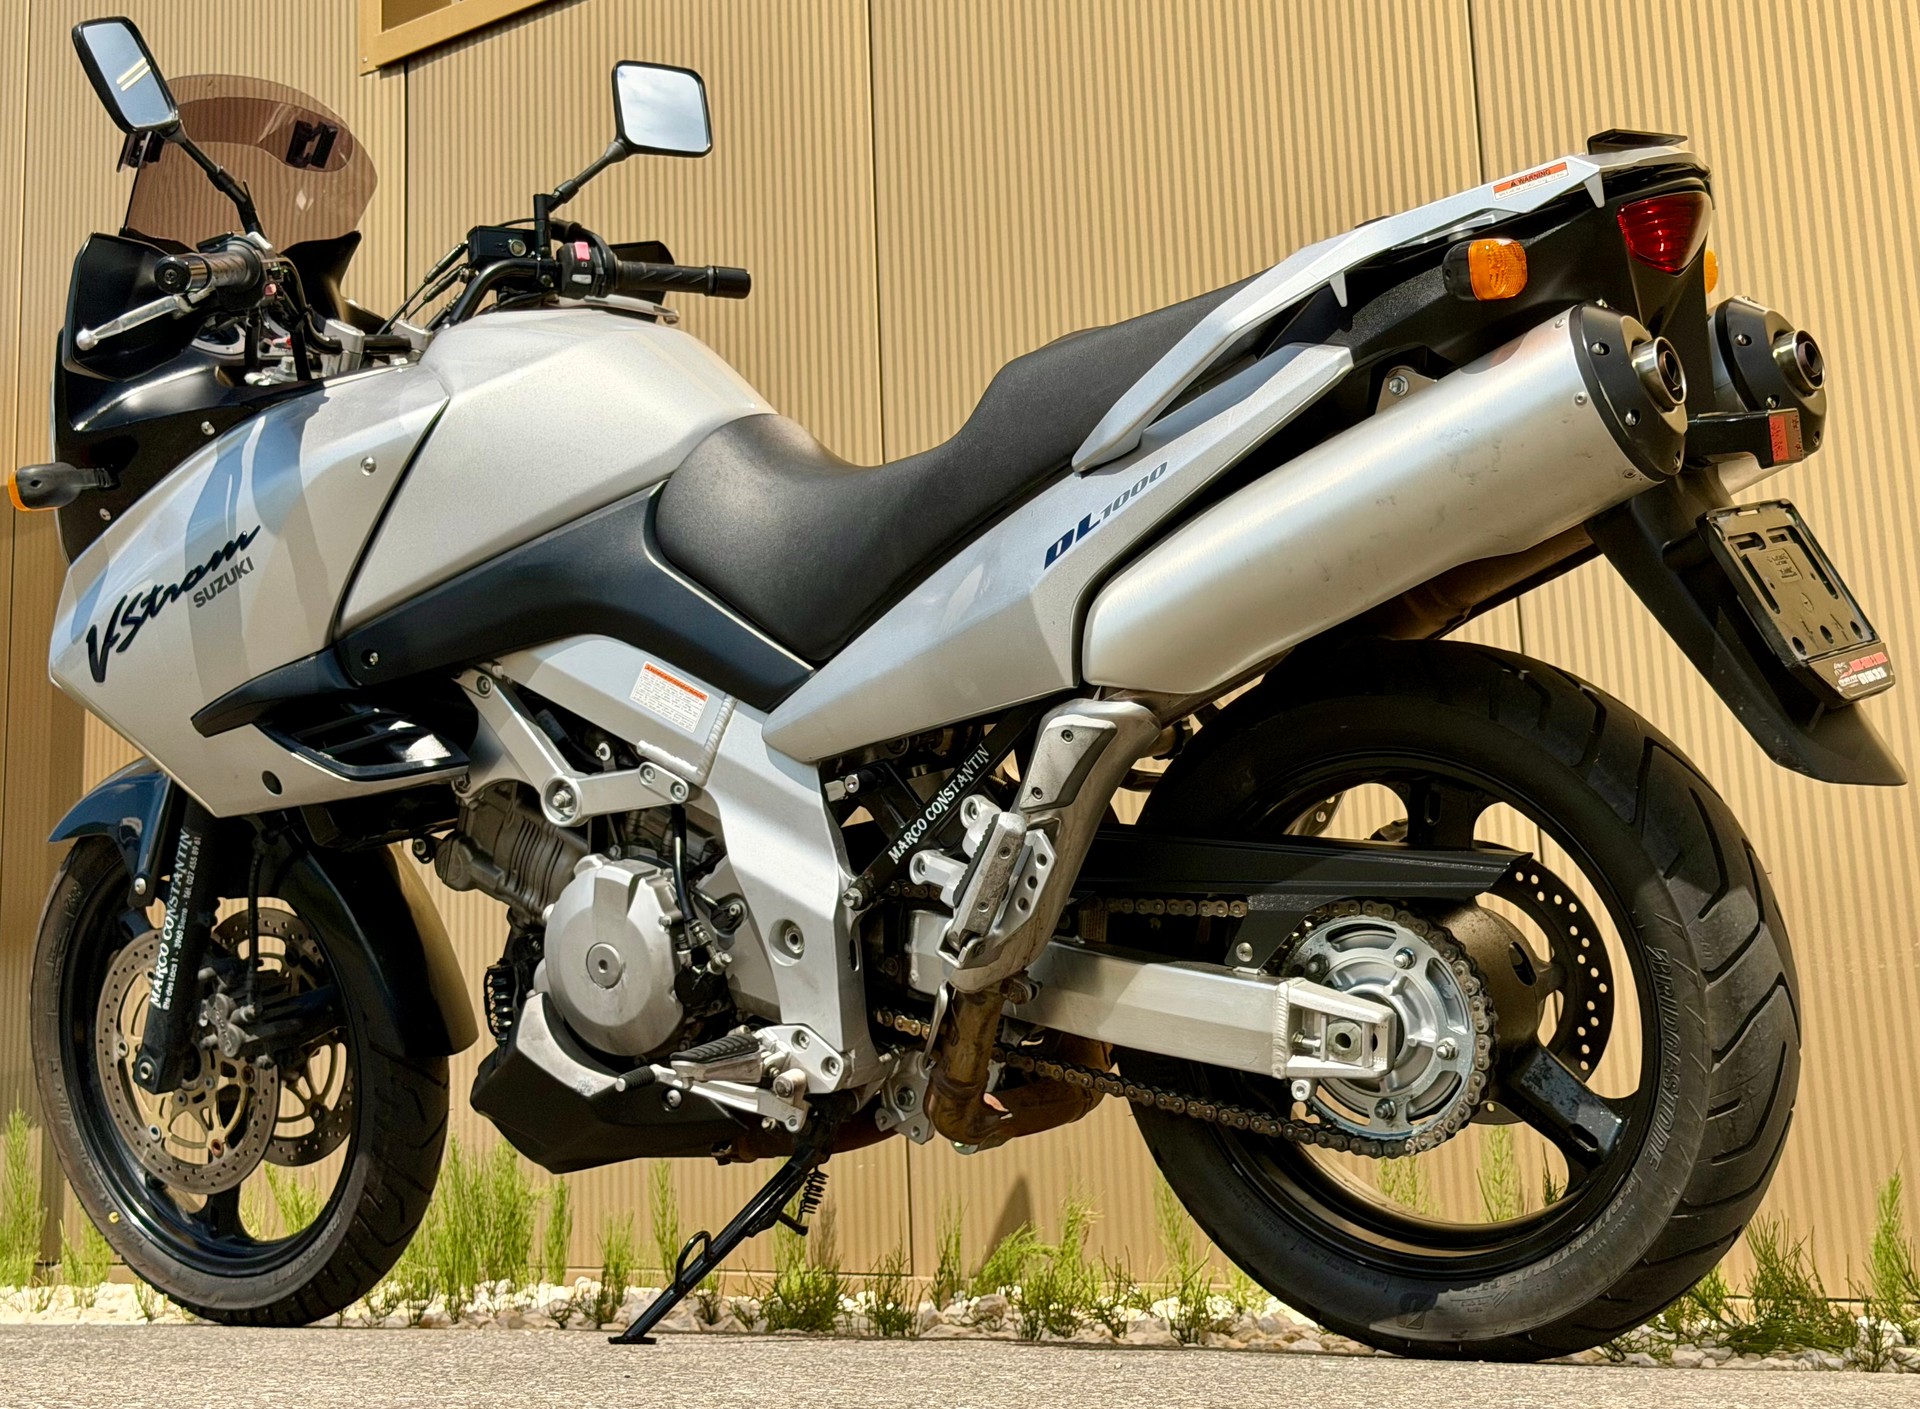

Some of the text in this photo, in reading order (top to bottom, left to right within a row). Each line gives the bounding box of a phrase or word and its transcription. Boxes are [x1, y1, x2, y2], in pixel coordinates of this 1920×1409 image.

[1518, 168, 1551, 184] WARNING
[1044, 462, 1168, 570] DL1000
[193, 556, 254, 608] SUZUKI
[887, 743, 990, 865] MARCO CONSTANTIN
[189, 857, 198, 870] 455
[186, 871, 195, 885] 027
[150, 828, 193, 1009] MARCO CONSTANTIN
[174, 931, 184, 949] 3960
[168, 963, 178, 982] Lacs
[166, 983, 174, 997] des
[1645, 945, 1681, 1171] BRIDGESTONE
